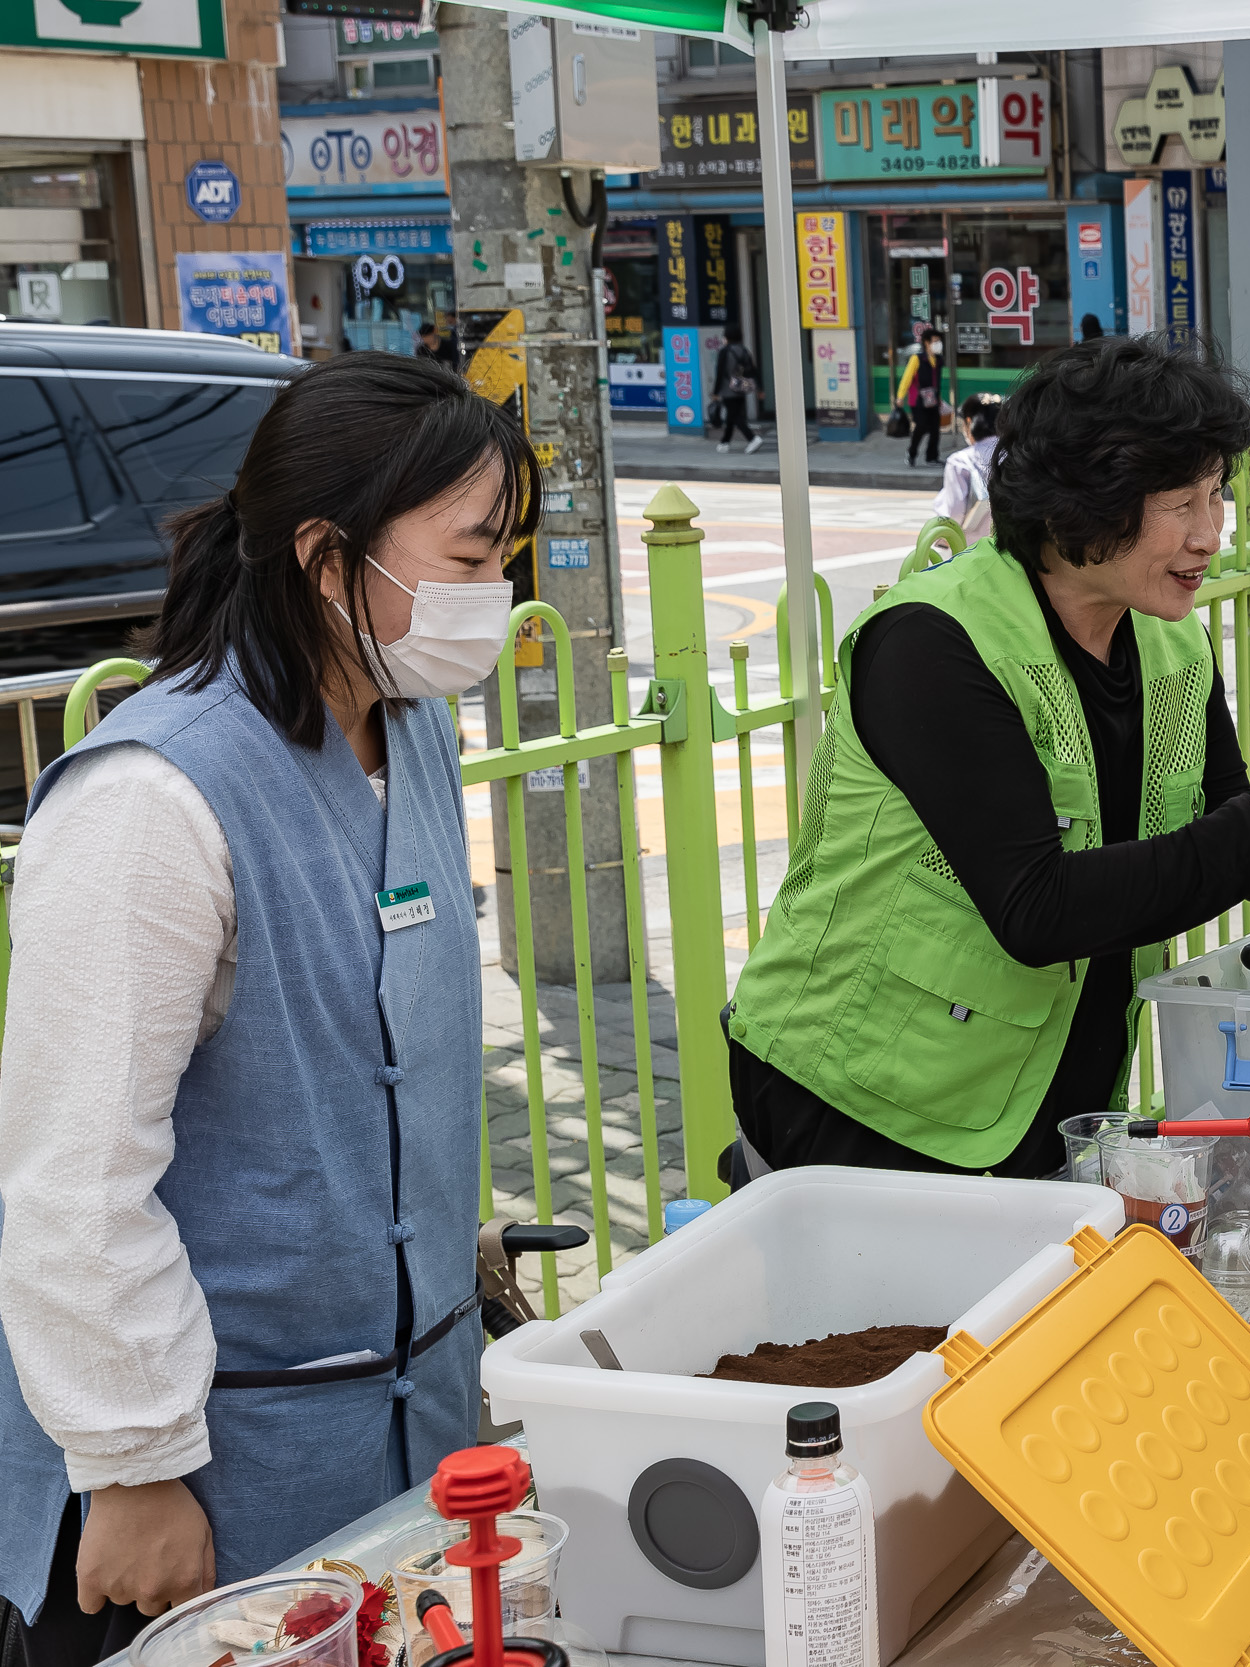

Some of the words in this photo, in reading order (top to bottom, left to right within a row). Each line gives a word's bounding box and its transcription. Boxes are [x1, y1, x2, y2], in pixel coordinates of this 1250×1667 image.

[383, 122, 440, 177] 안경
[1002, 91, 1046, 158] 약
[196, 180, 233, 204] ADT
[806, 235, 840, 325] 한의원
[980, 266, 1040, 345] 약
[671, 334, 694, 401] 안경
[1168, 1209, 1181, 1231] 2
